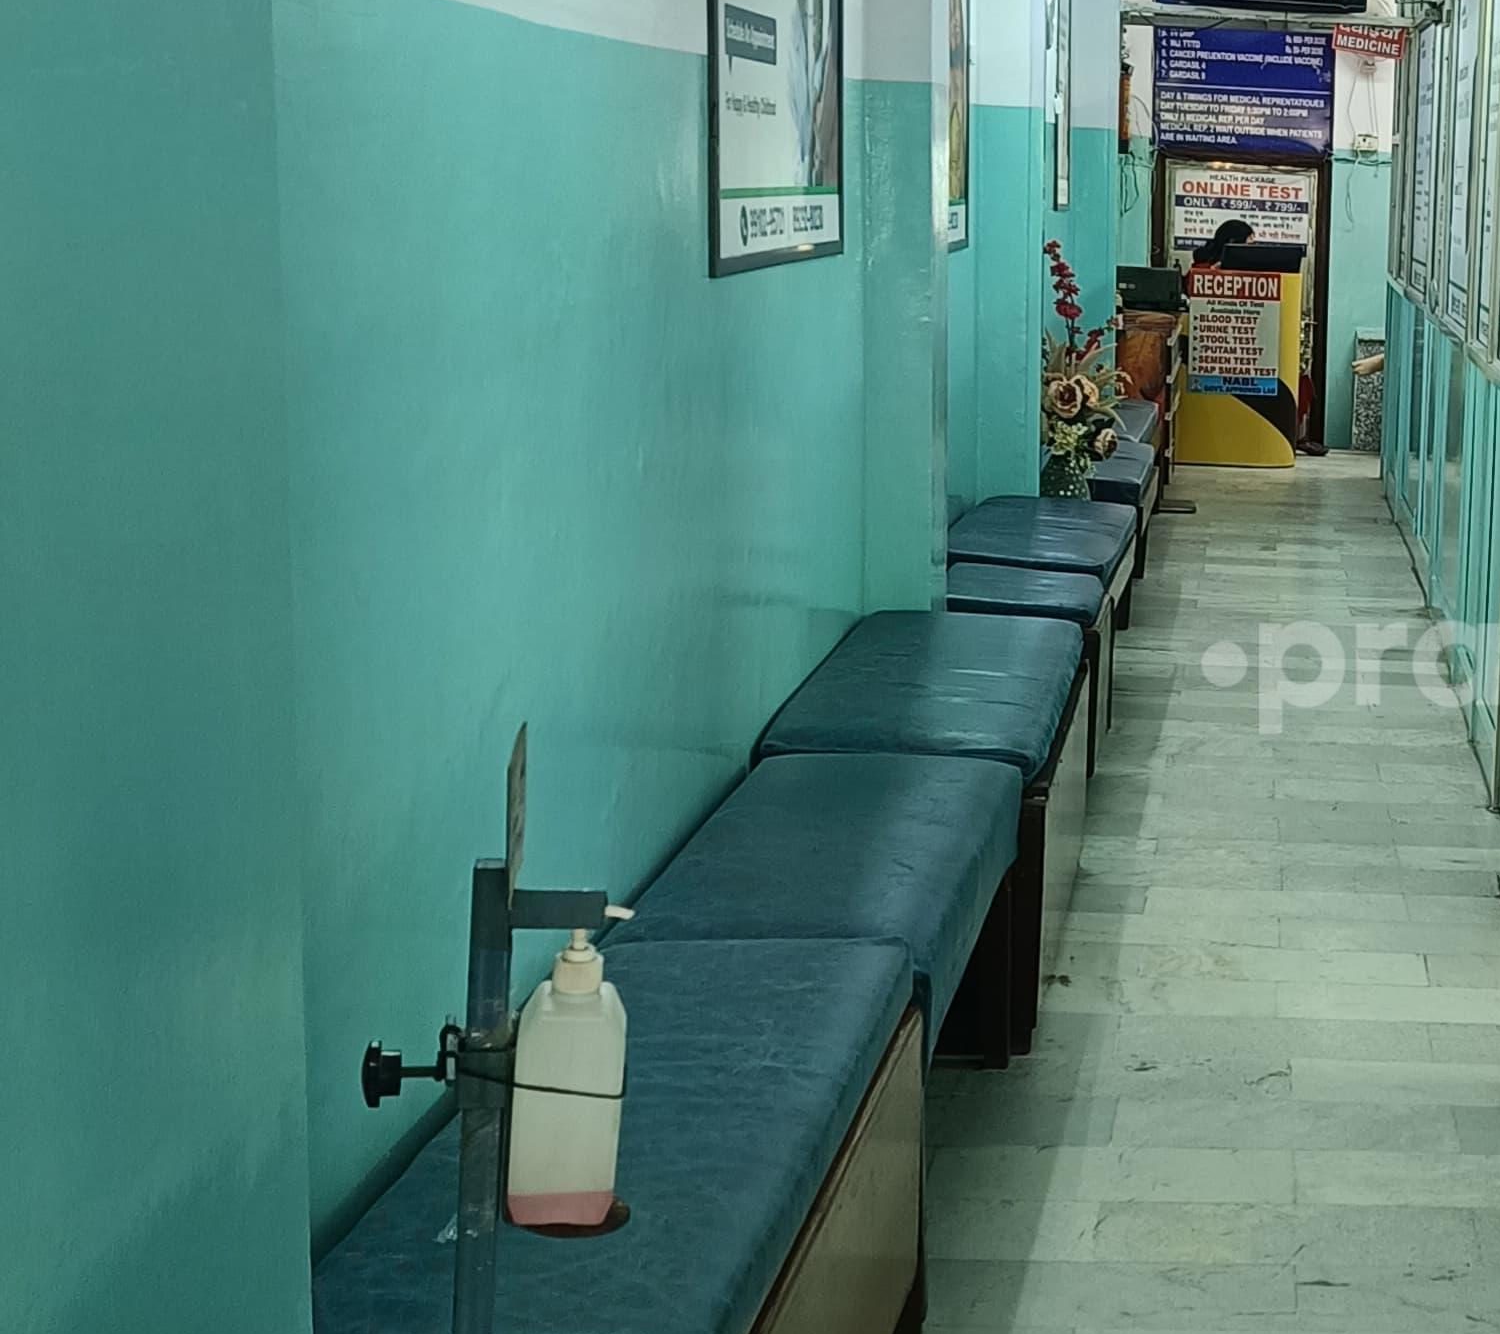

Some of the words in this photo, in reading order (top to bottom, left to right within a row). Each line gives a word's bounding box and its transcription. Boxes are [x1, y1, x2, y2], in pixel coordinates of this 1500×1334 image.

[1336, 34, 1401, 55] MEDICINE
[1160, 91, 1175, 100] DAY
[1213, 94, 1229, 103] FOR
[1229, 94, 1261, 104] MEDICAL
[1160, 102, 1175, 111] DAY
[1176, 103, 1210, 113] TUESDAY
[1210, 104, 1219, 113] TO
[1220, 105, 1245, 115] FRIDAY
[1272, 107, 1282, 117] TO
[1160, 112, 1179, 122] ONLY
[1185, 114, 1218, 124] MEDICAL
[1234, 116, 1249, 125] PER
[1251, 117, 1265, 126] DAY
[1160, 122, 1192, 132] MEDICAL
[1215, 125, 1234, 134] WAIT
[1234, 125, 1266, 136] OUTSIDE
[1266, 127, 1288, 137] WHEN
[1288, 128, 1323, 139] PATIENTS
[1160, 133, 1175, 142] ARE
[1176, 133, 1185, 142] IN
[1185, 134, 1215, 144] WAITING
[1209, 174, 1239, 183] HEALTH
[1240, 176, 1276, 184] PACKAGE
[1182, 180, 1251, 198] ONLINE
[1256, 184, 1303, 200] TEST
[1183, 197, 1215, 208] ONLY
[1192, 273, 1279, 298] RECEPTION
[1218, 300, 1238, 308] Kinds
[1239, 300, 1248, 308] Of
[1210, 307, 1242, 315] Available
[1243, 308, 1261, 316] Here
[1199, 315, 1232, 324] BLOOD
[1234, 316, 1259, 325] TEST
[1199, 324, 1230, 334] URINE
[1232, 326, 1257, 335] TEST
[1198, 335, 1231, 344] STOOL
[1233, 336, 1257, 345] TEST
[1240, 347, 1264, 356] TEST
[1198, 355, 1231, 365] SEMEN
[1233, 357, 1258, 366] TEST
[1198, 365, 1216, 375] PAP
[1218, 366, 1252, 376] SMEAR
[1253, 368, 1277, 377] TEST
[1222, 376, 1259, 386] NABL
